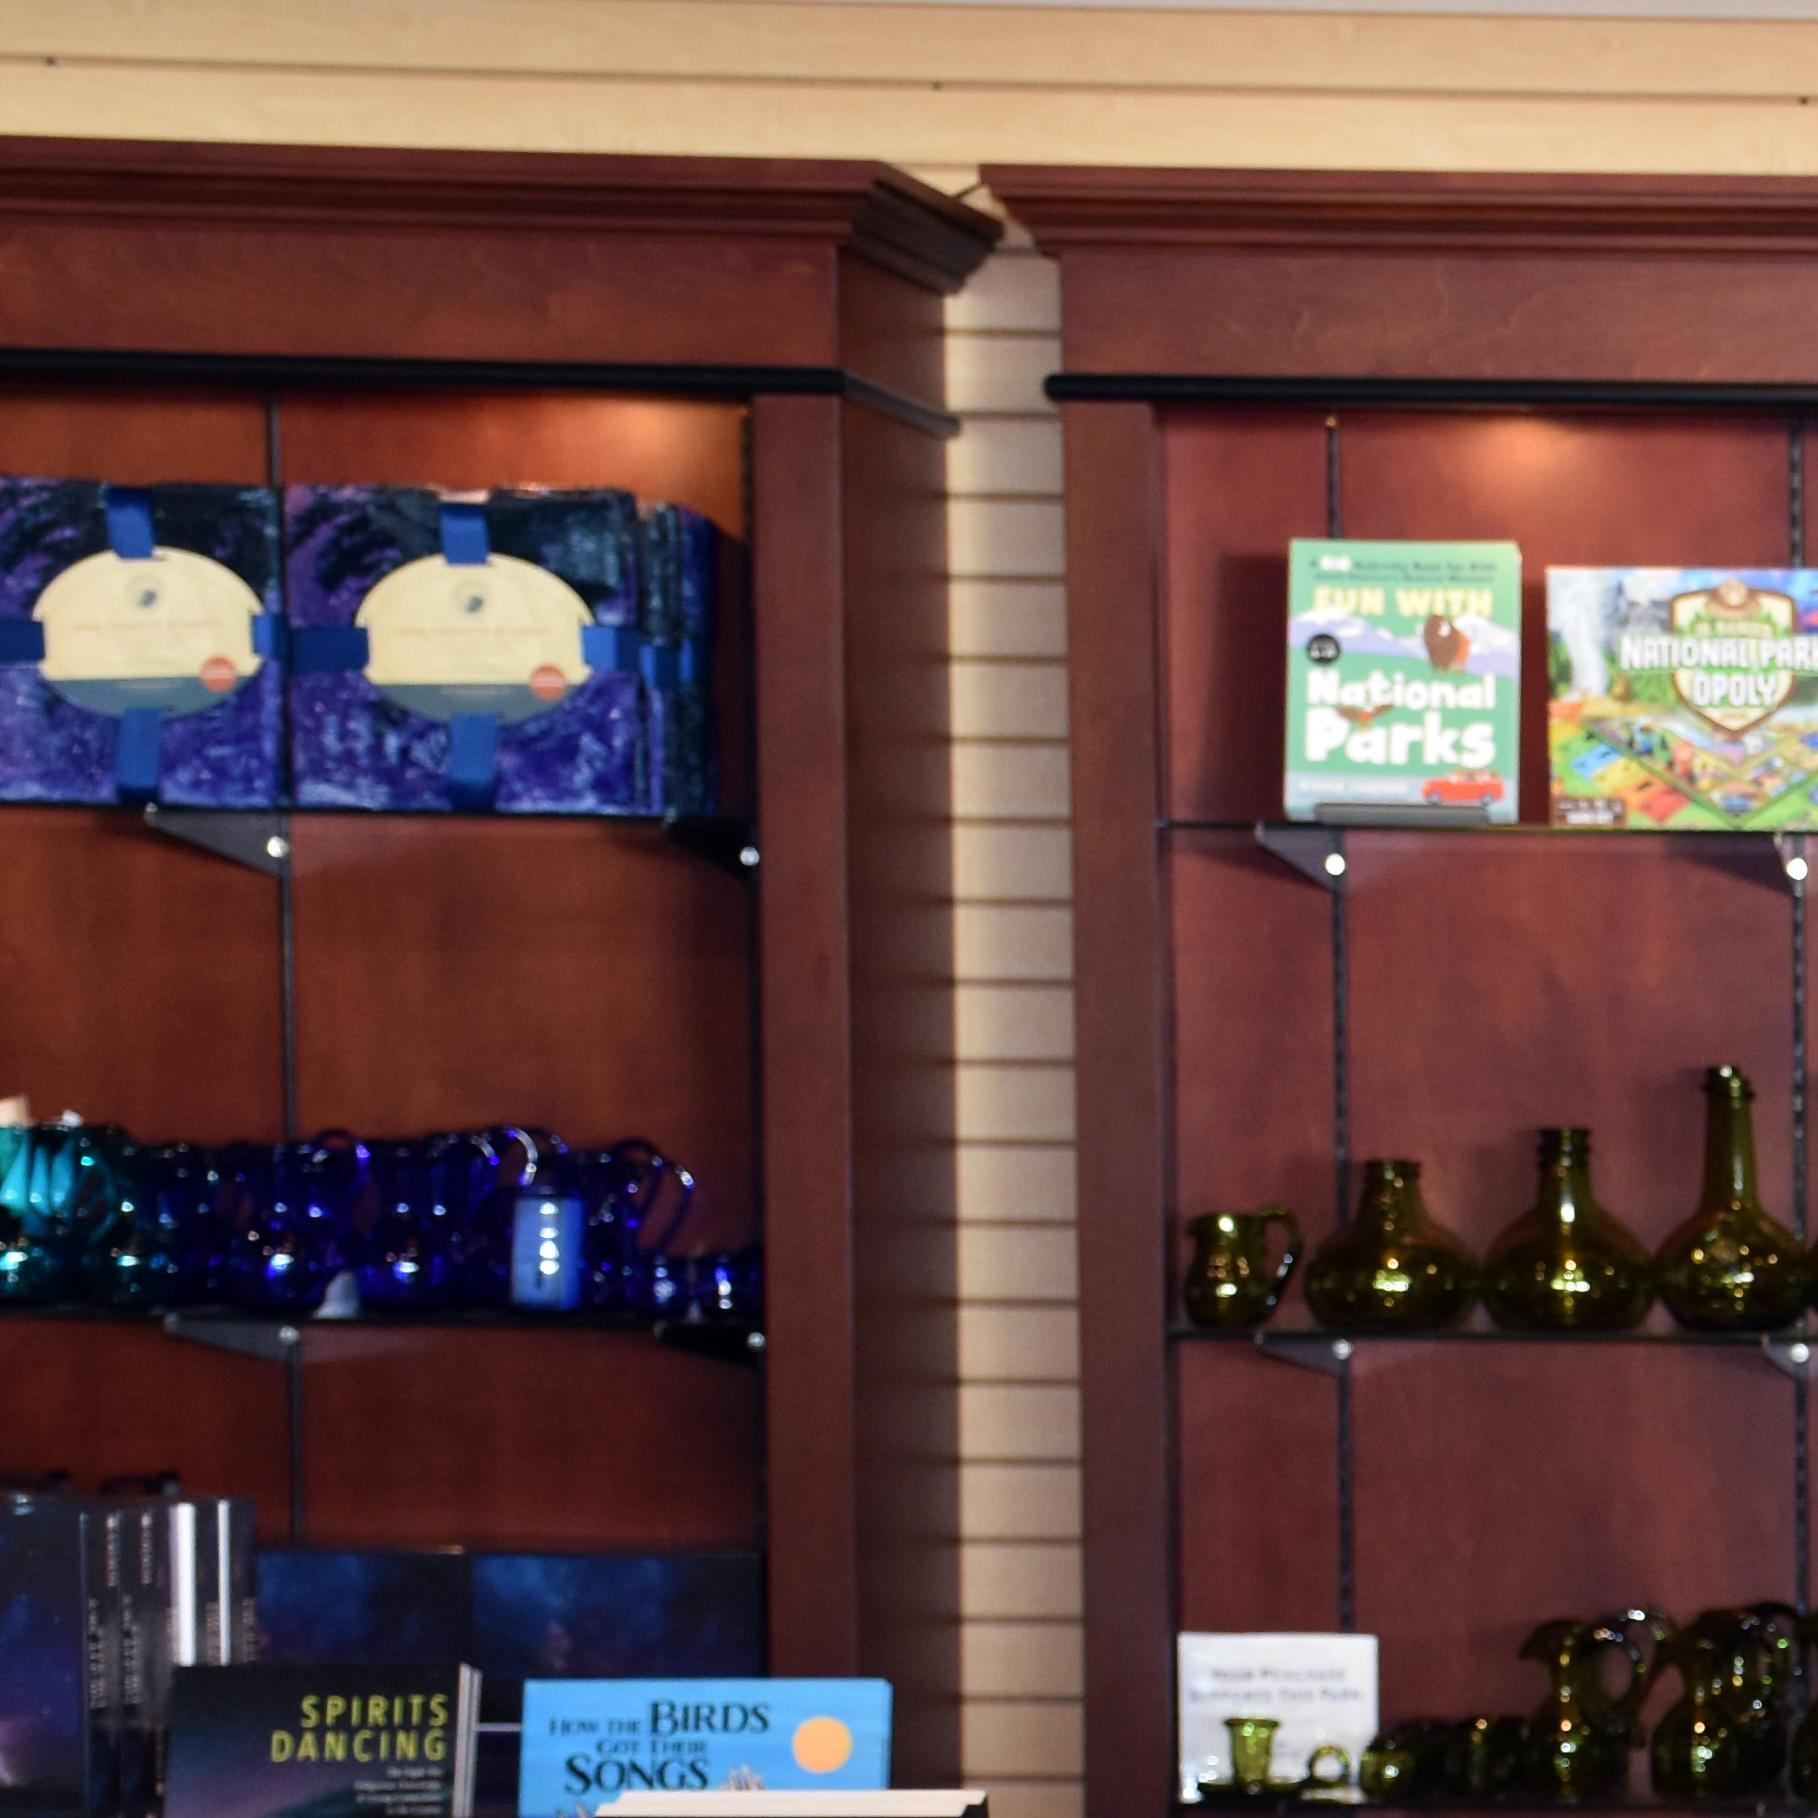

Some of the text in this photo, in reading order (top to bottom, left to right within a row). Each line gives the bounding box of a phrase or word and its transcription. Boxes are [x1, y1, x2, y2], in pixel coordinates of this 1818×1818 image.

[1312, 585, 1493, 617] FUN WITH
[1621, 635, 1749, 670] NATIONAL
[1306, 669, 1496, 710] National
[1694, 674, 1777, 707] OPOLY
[1305, 707, 1496, 768] Parks
[301, 1694, 449, 1728] SPIRITS
[550, 1699, 771, 1737] HOW THE BIRDS
[271, 1729, 446, 1762] DANCING
[565, 1753, 710, 1795] SONGS
